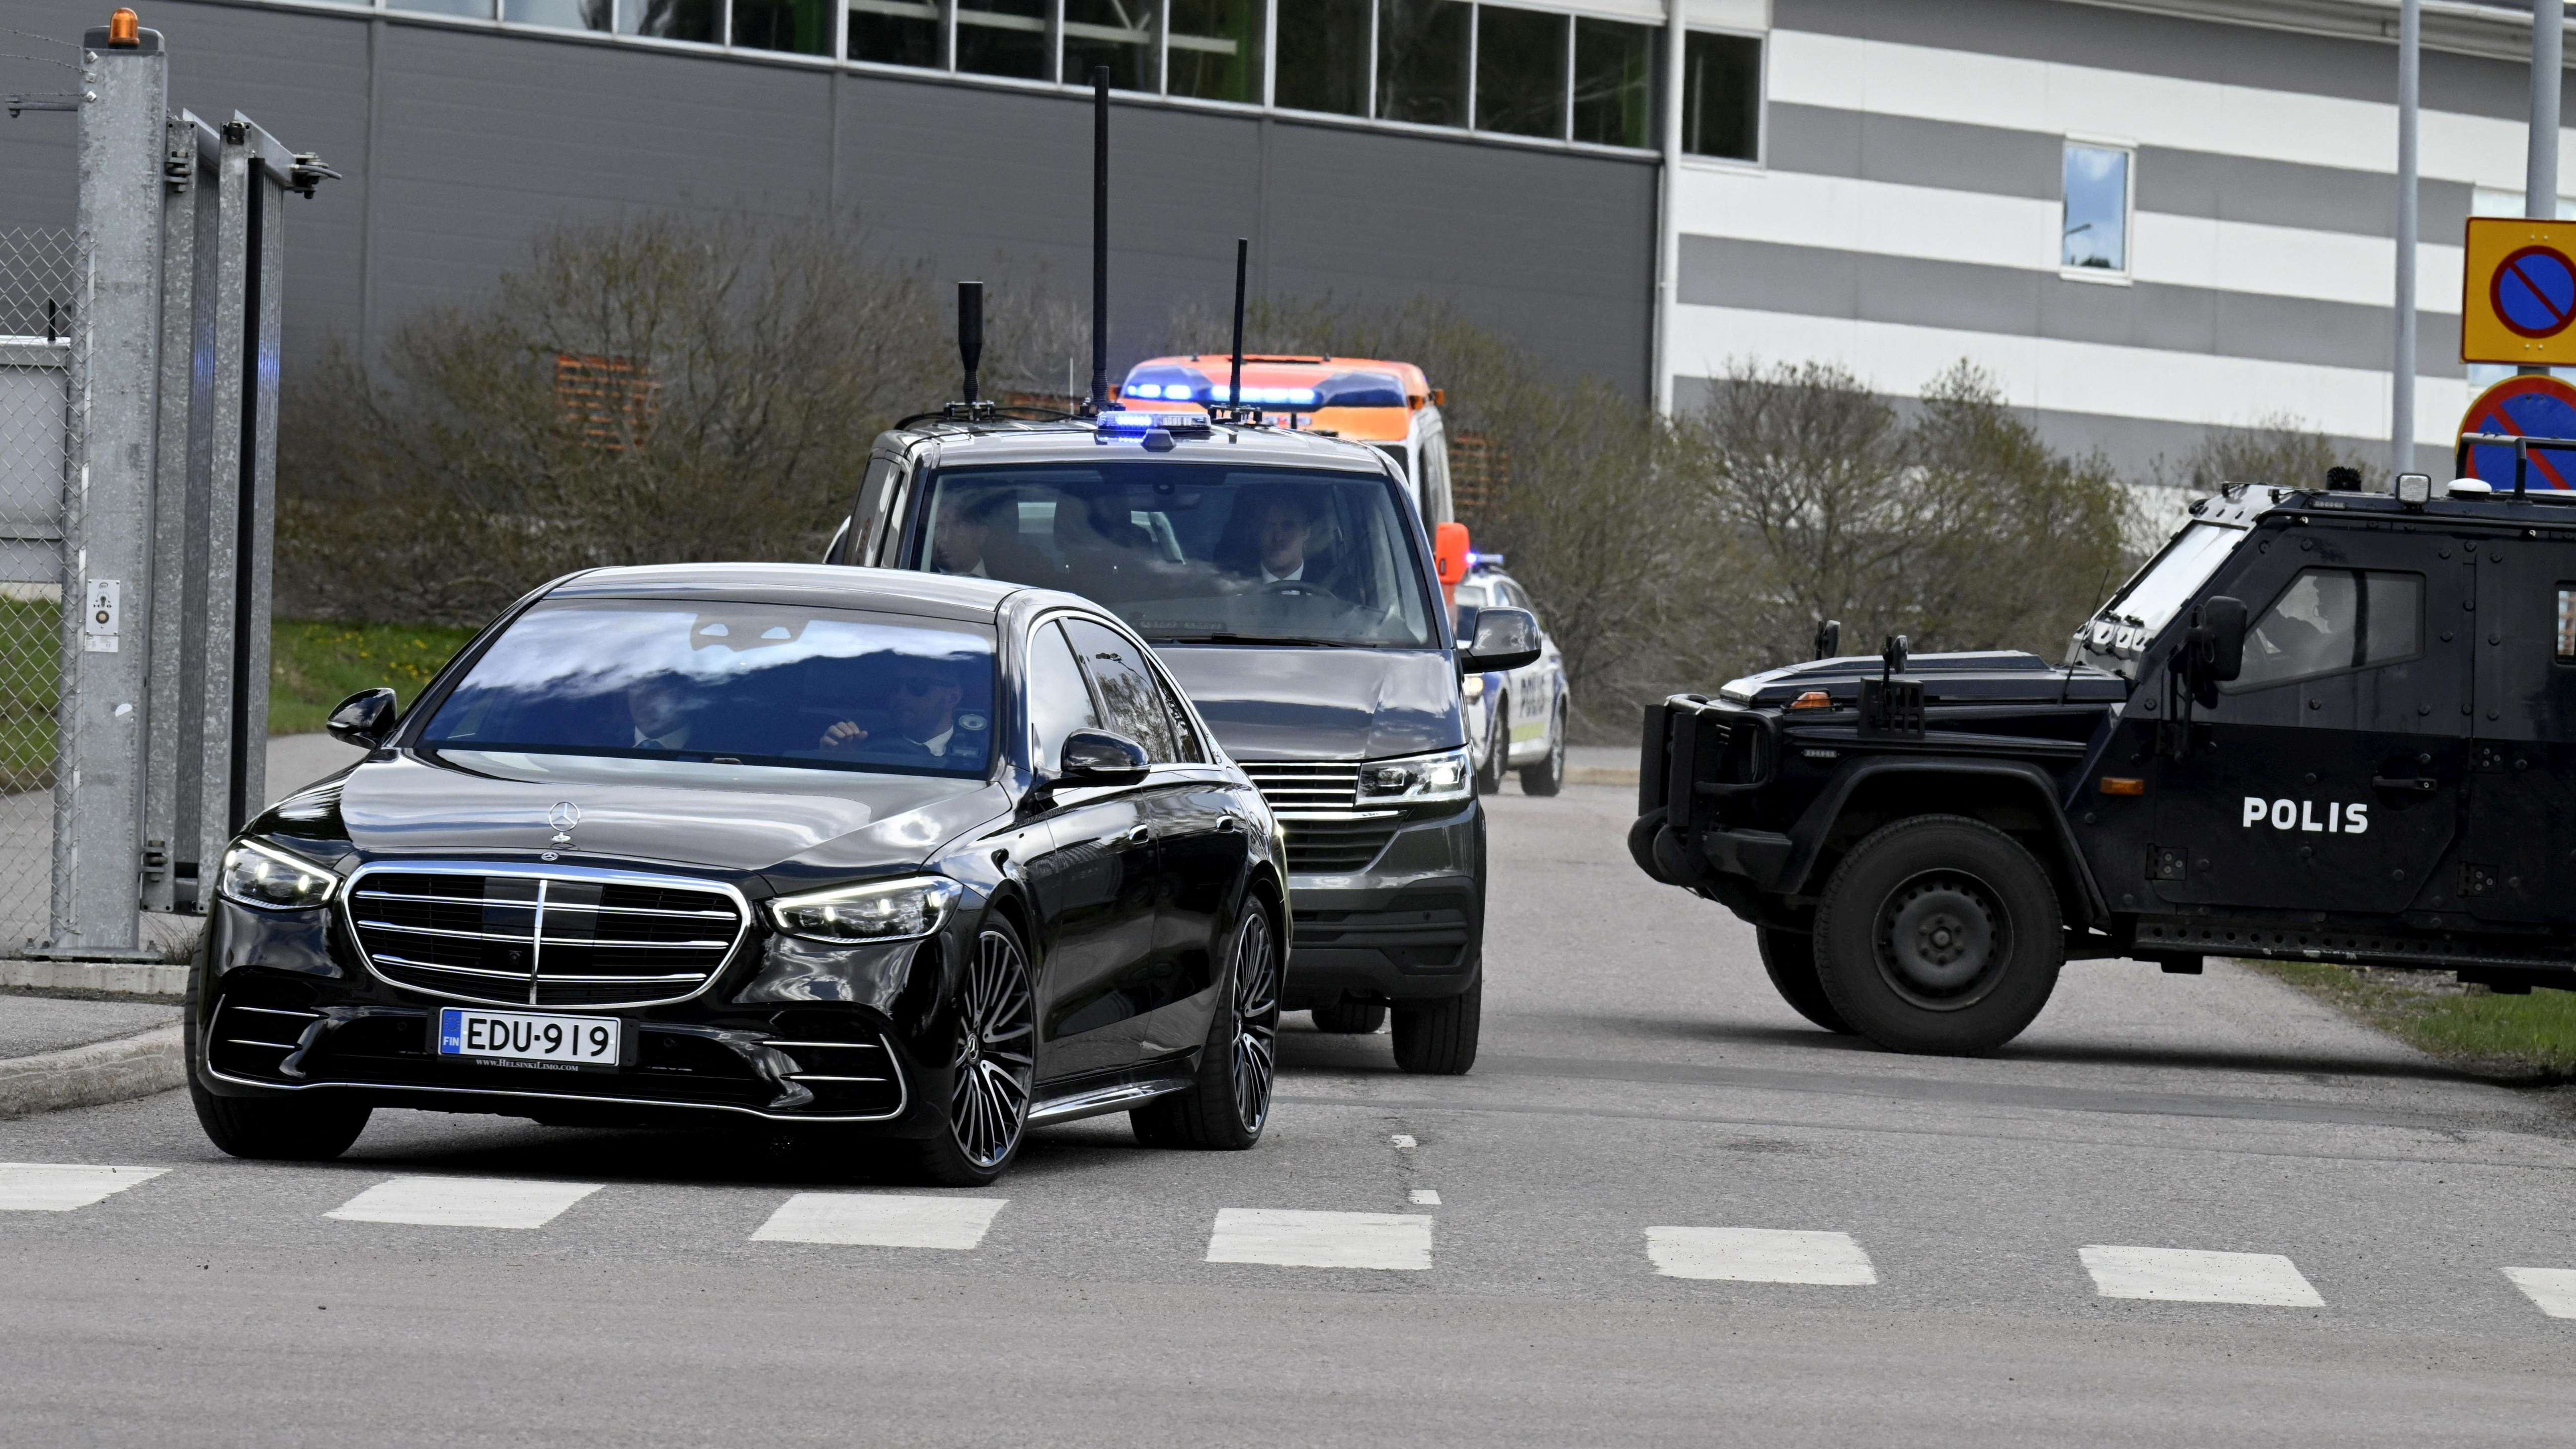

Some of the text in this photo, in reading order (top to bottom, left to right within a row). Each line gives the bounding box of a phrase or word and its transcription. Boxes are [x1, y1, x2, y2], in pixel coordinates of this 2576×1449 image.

[2243, 796, 2368, 834] POLIS
[443, 1036, 459, 1046] FIN
[467, 1018, 609, 1057] EDU-919
